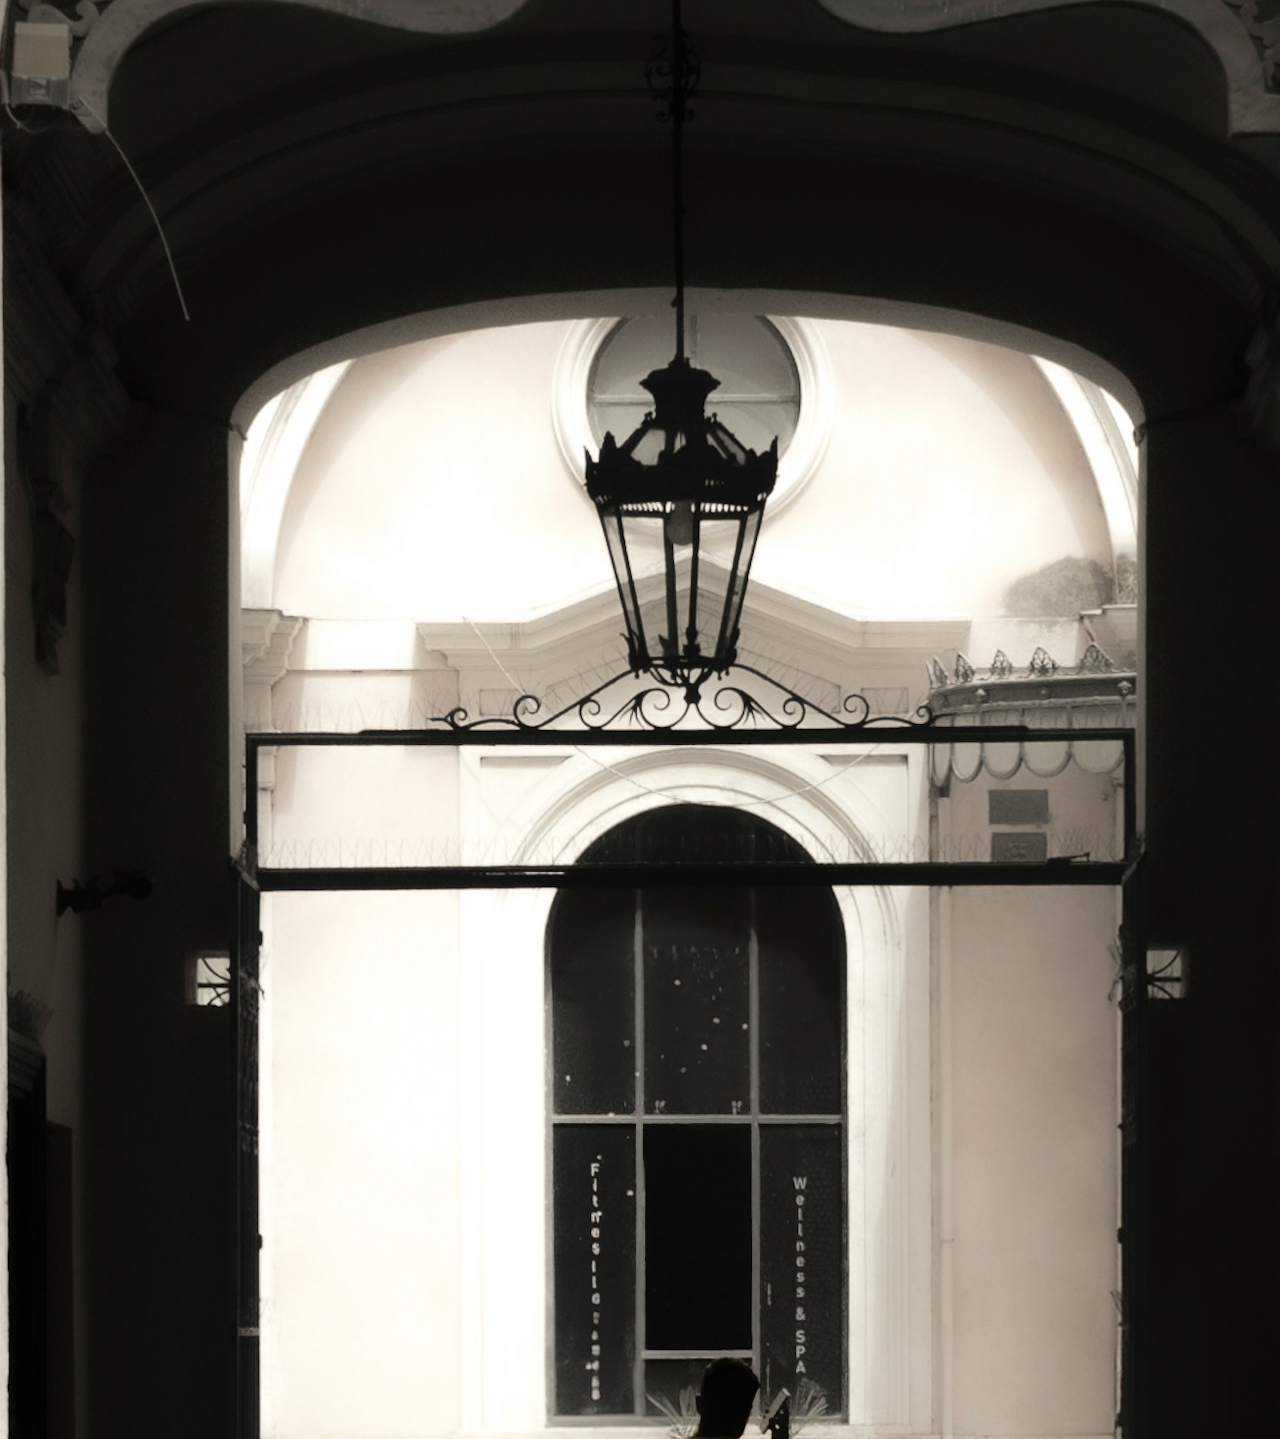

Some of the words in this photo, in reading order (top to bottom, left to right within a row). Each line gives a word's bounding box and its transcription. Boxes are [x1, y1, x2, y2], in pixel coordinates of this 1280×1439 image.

[793, 1177, 807, 1298] Wellness
[795, 1307, 806, 1321] &
[795, 1329, 807, 1374] SPA
